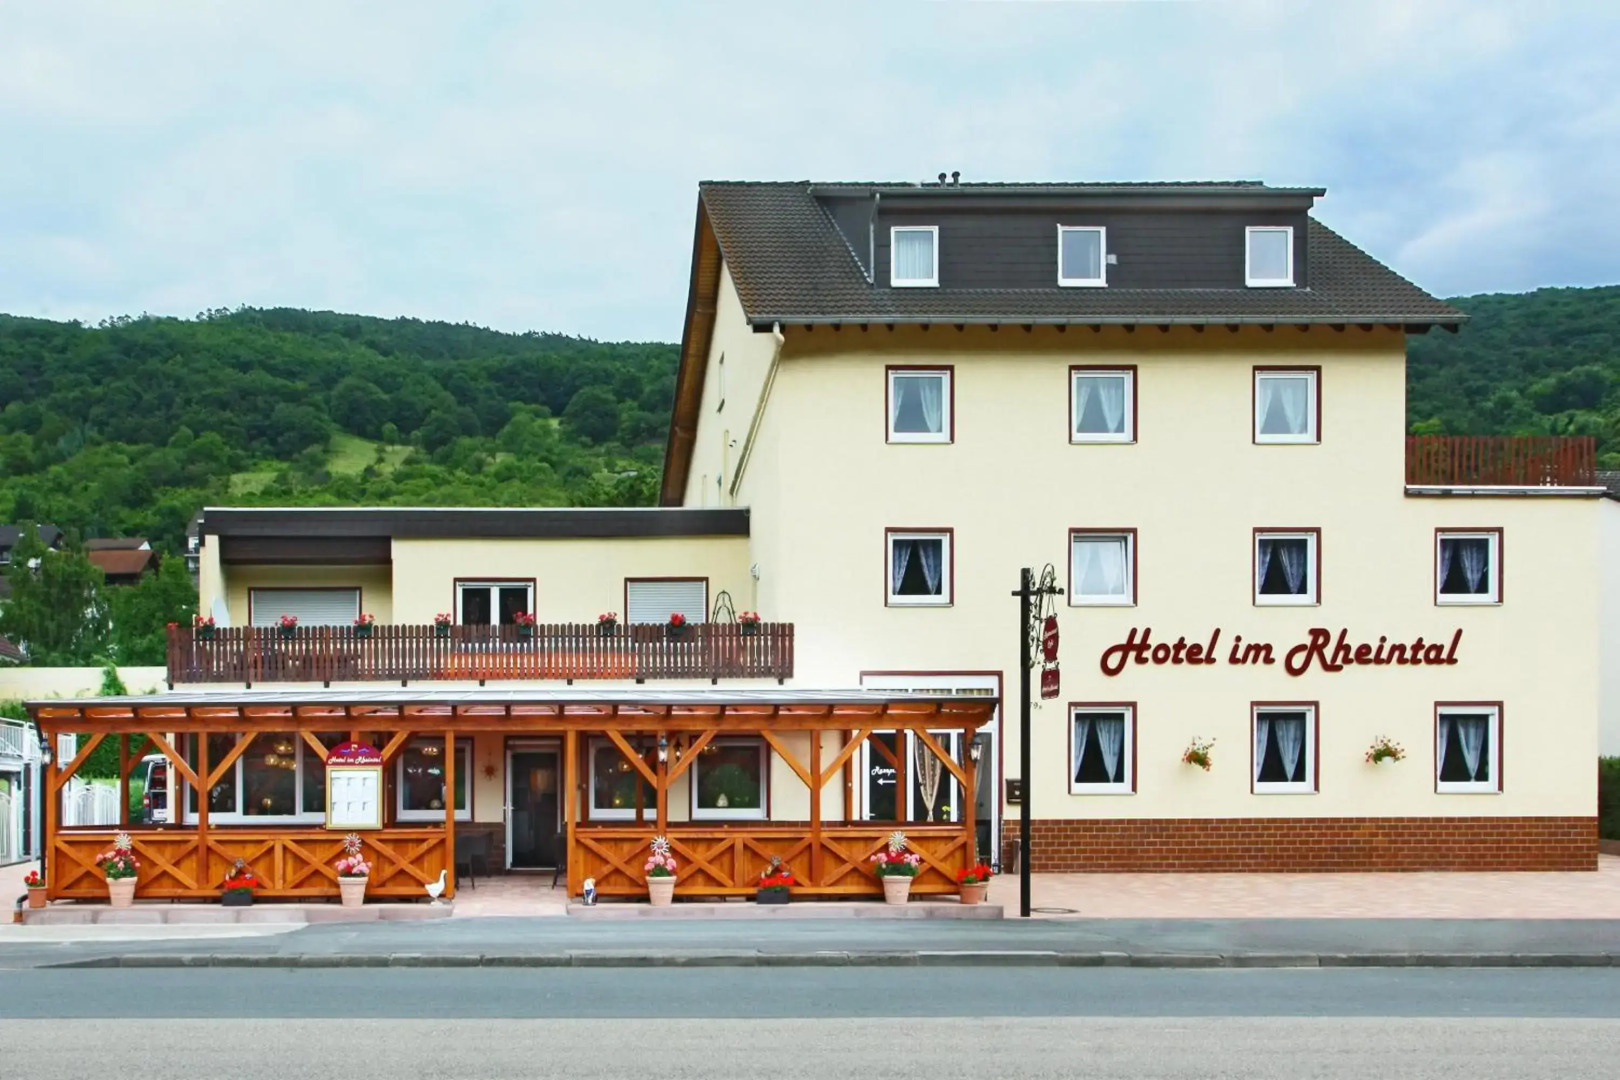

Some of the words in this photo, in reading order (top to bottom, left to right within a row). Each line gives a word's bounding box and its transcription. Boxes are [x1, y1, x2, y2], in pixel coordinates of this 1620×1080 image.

[1100, 627, 1221, 677] Hotel
[1228, 635, 1275, 665] im
[1285, 627, 1463, 677] Rheintal
